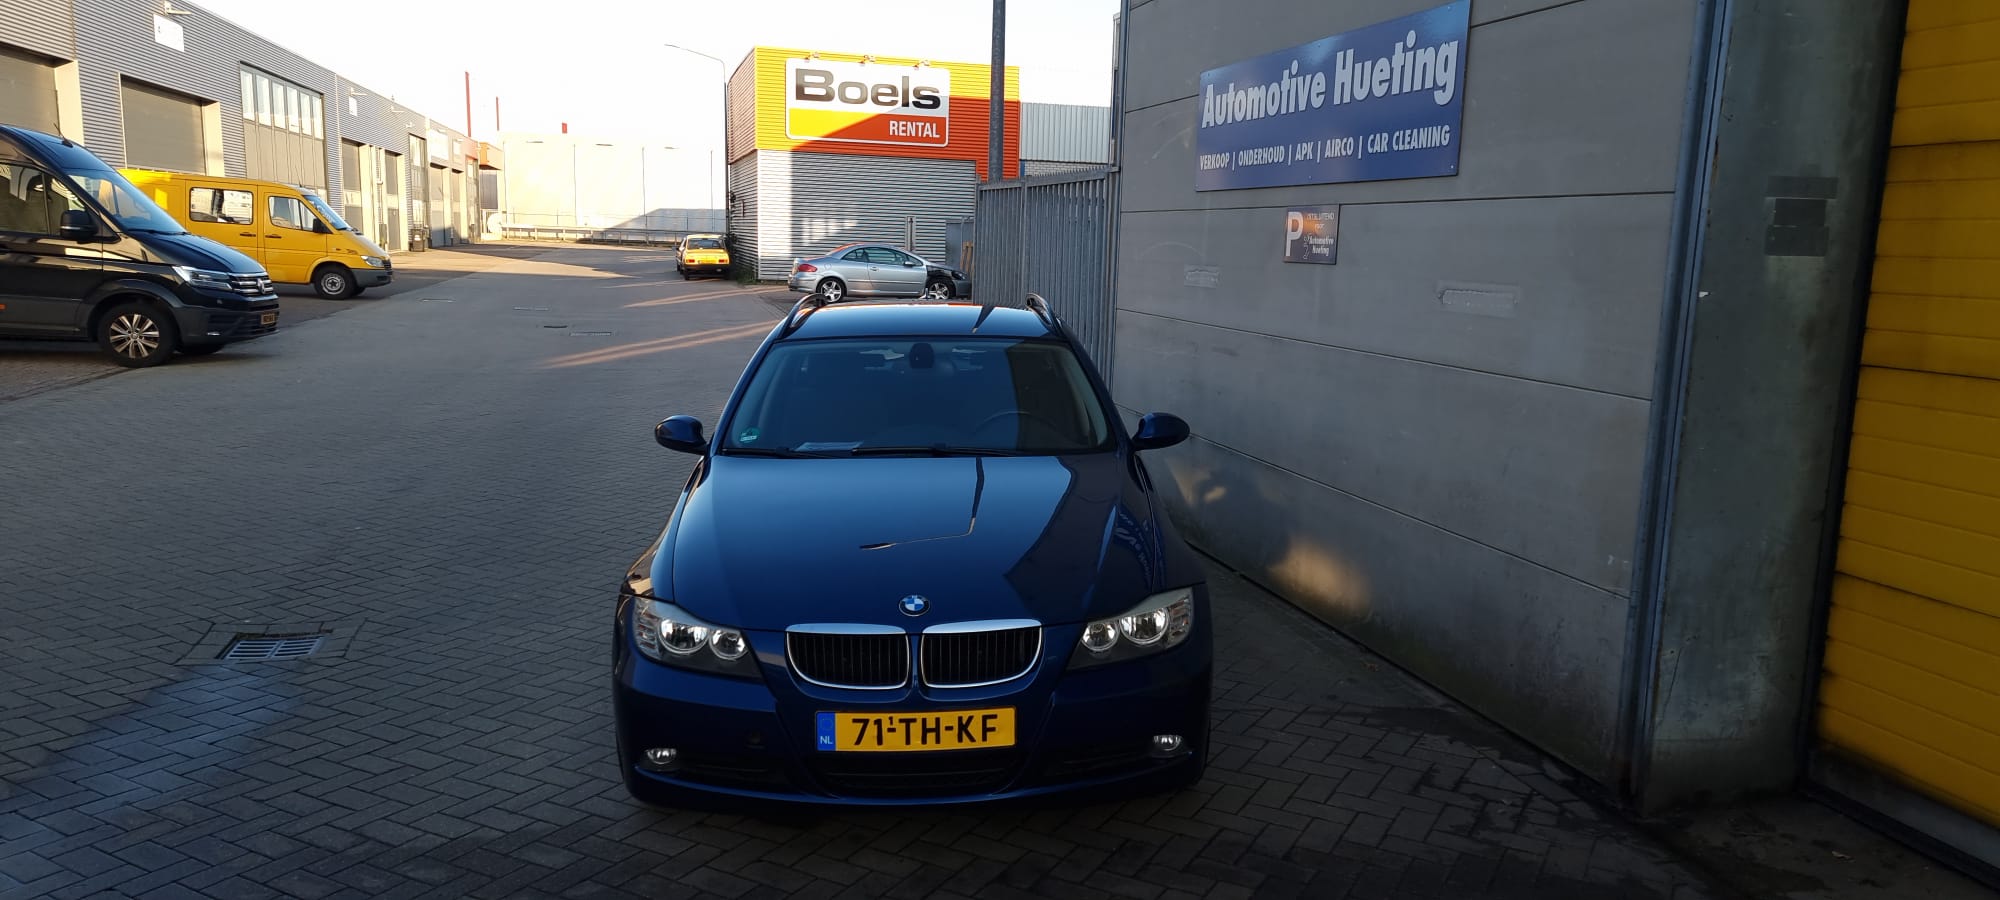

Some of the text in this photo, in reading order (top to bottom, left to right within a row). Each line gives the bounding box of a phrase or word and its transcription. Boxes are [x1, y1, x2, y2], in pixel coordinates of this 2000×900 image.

[795, 68, 941, 110] Boels
[1201, 30, 1459, 129] Automotive Hueting
[889, 120, 940, 139] RENTAL
[1199, 124, 1451, 171] VERKOOP ONDERHOUD APK AIRCO CAR CLEANING
[1285, 211, 1304, 257] P
[819, 735, 833, 745] NL
